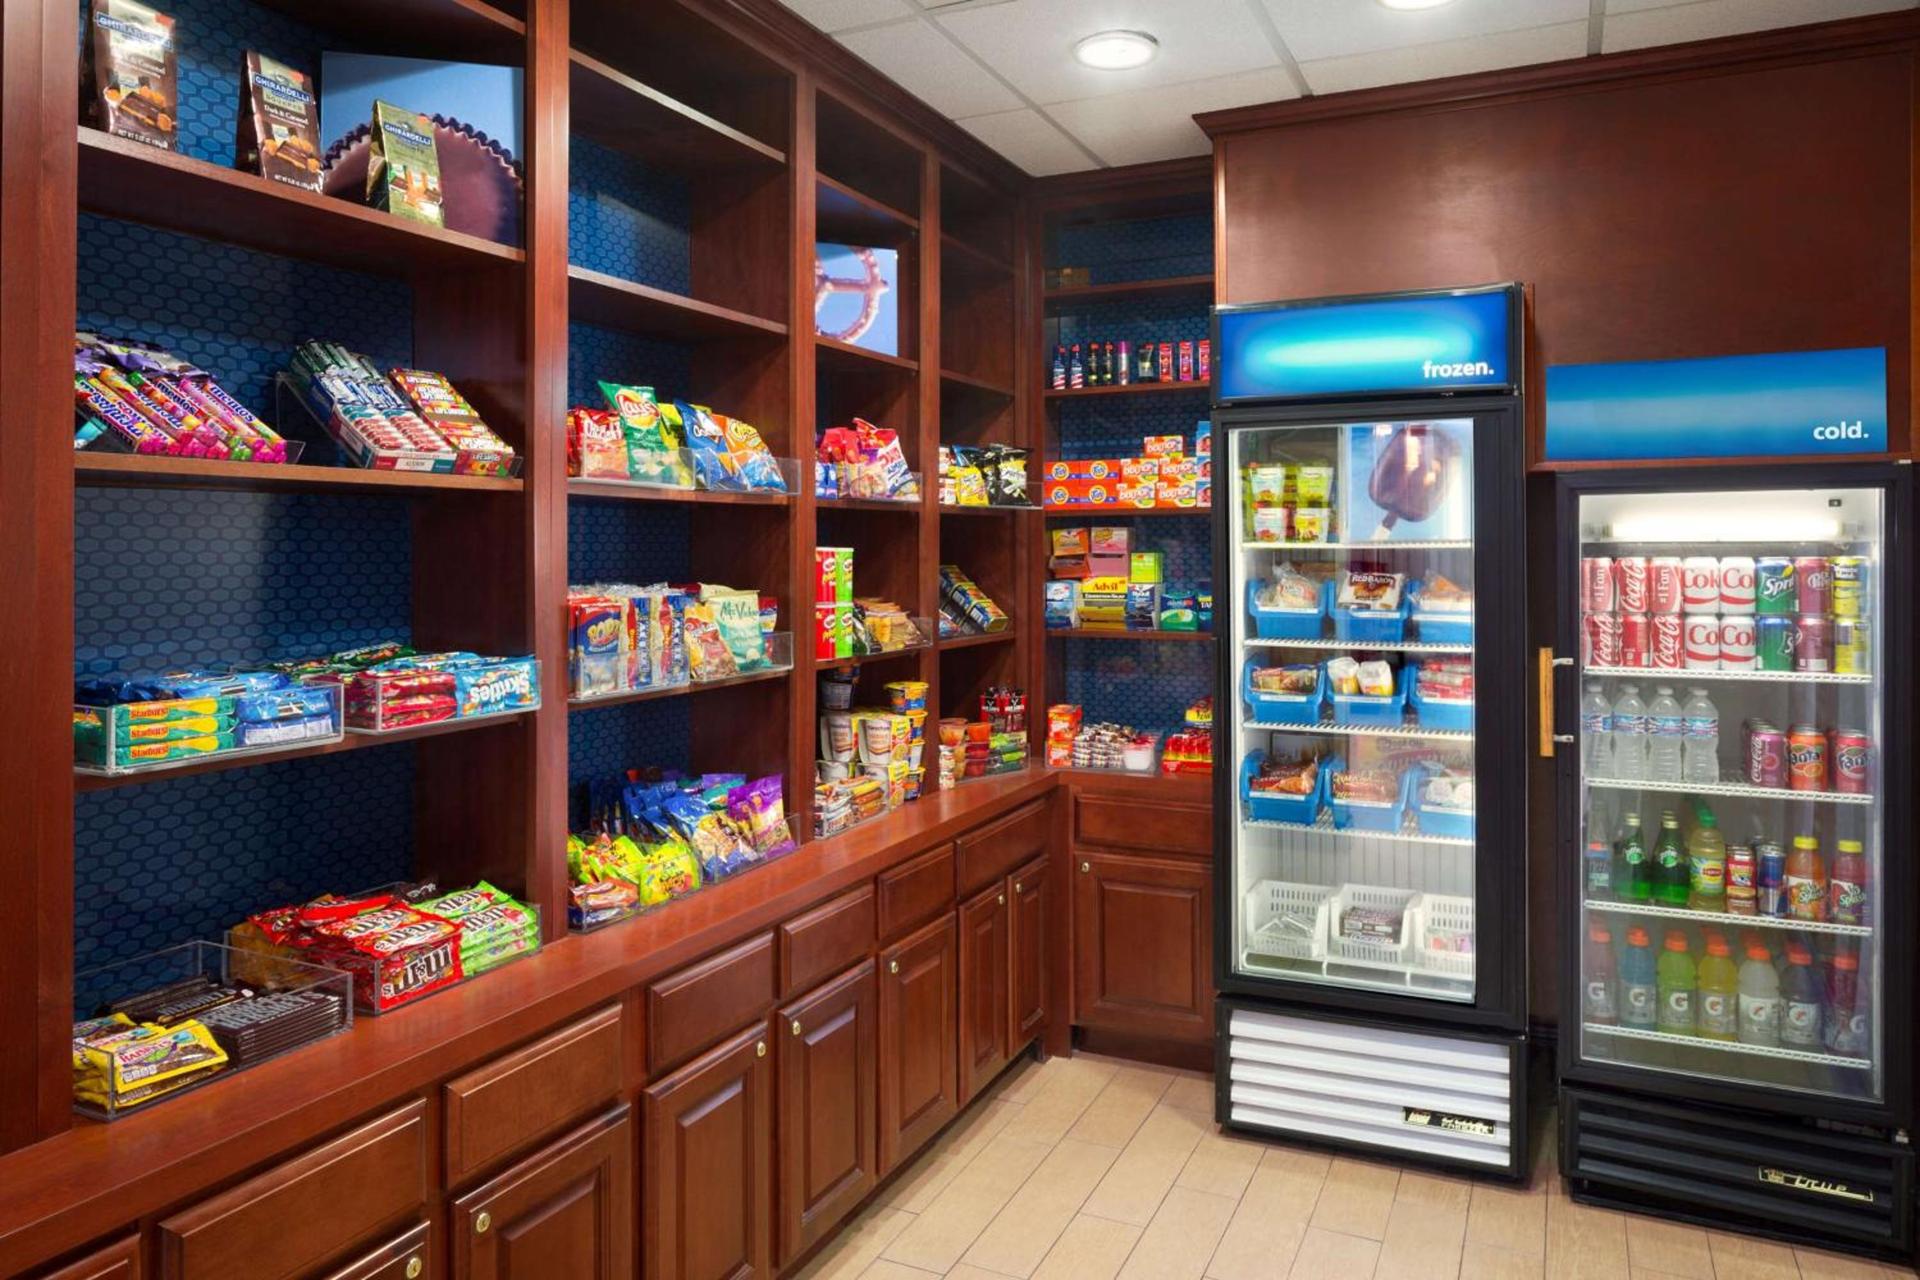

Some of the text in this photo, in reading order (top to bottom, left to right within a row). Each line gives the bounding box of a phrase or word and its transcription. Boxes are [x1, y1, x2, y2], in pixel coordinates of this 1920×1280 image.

[255, 76, 310, 102] GHIRARDELLI
[384, 124, 431, 145] GHIRARDELLI
[1422, 360, 1494, 378] frozen.
[157, 382, 196, 416] mentos
[210, 385, 255, 422] mentos
[1813, 421, 1869, 440] cold.
[1092, 582, 1118, 591] Advil
[470, 664, 530, 703] Skittles
[131, 706, 167, 719] Starburst
[131, 725, 168, 738] Starburst
[131, 745, 168, 758] Starburst
